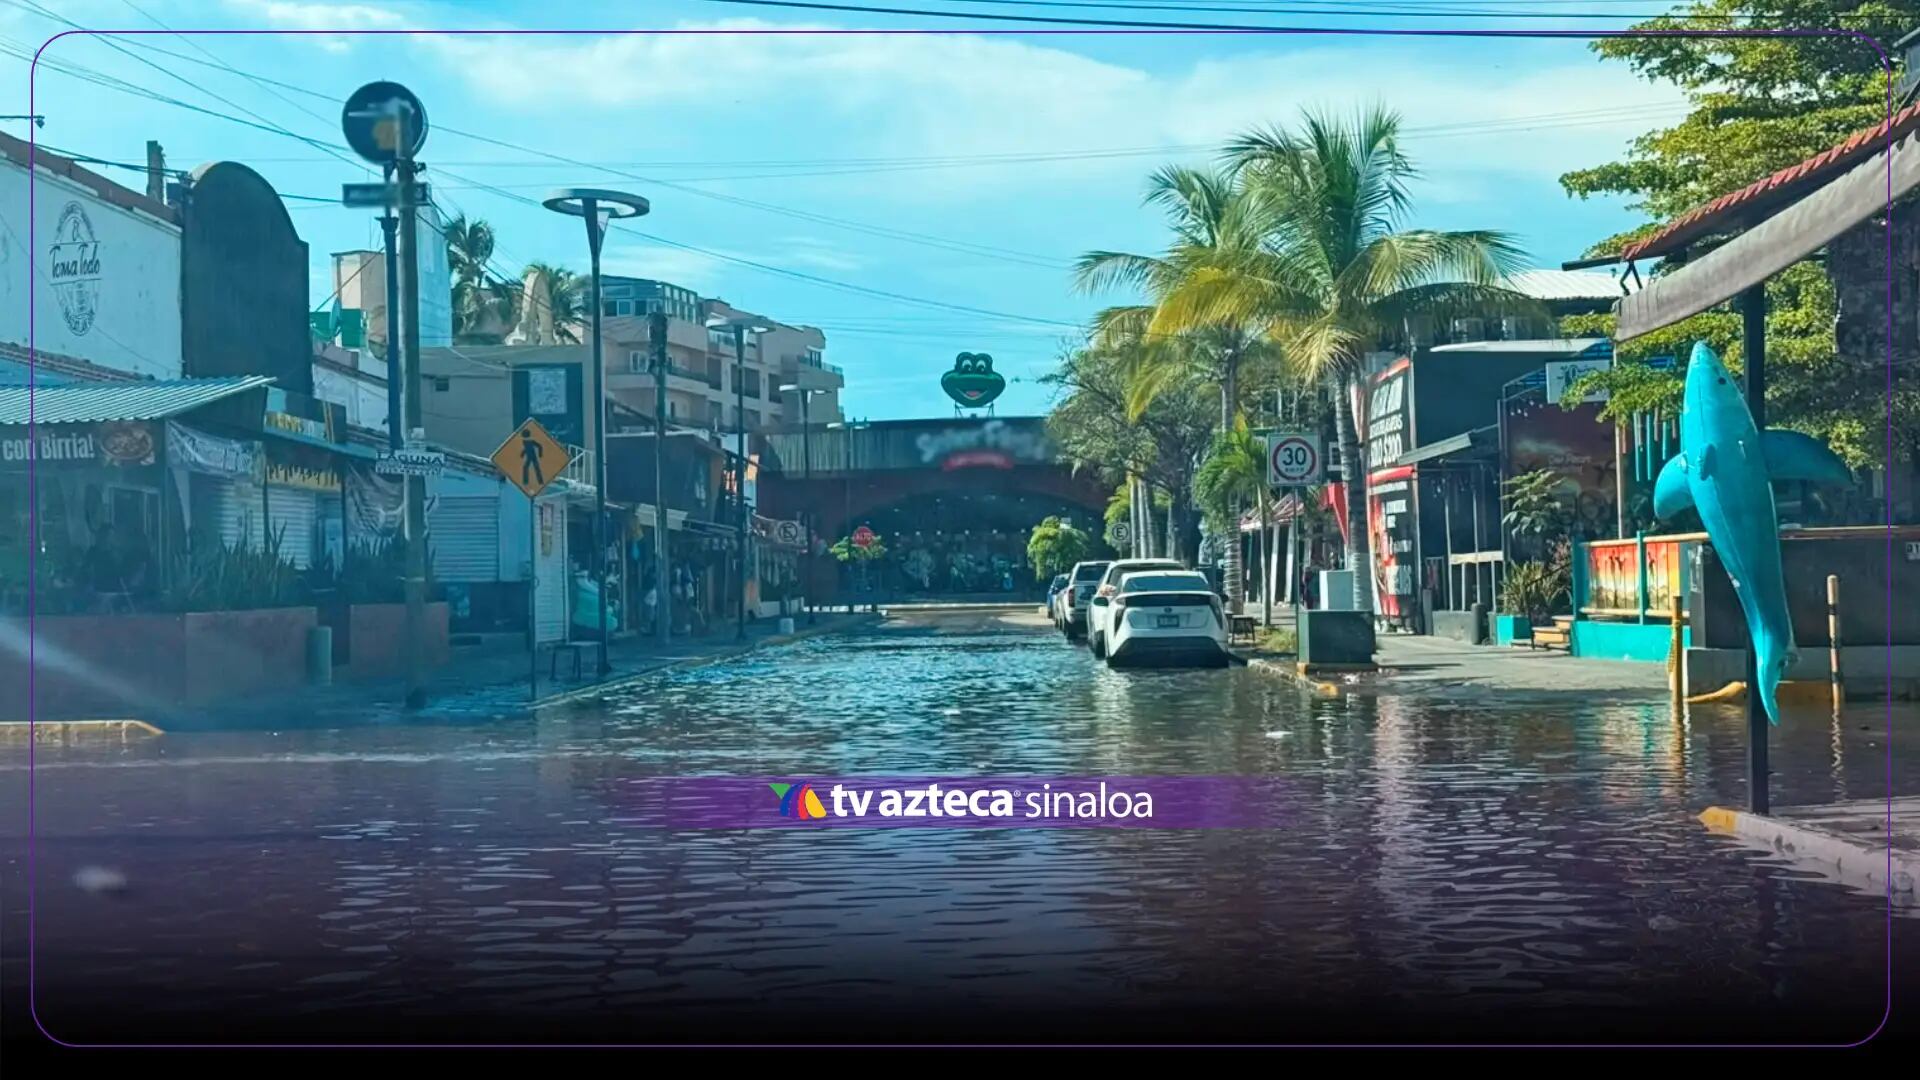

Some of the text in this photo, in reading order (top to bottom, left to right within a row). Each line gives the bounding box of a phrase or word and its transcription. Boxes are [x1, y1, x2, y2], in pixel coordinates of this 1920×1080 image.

[2, 433, 95, 460] con Birria!
[1282, 447, 1306, 466] 30
